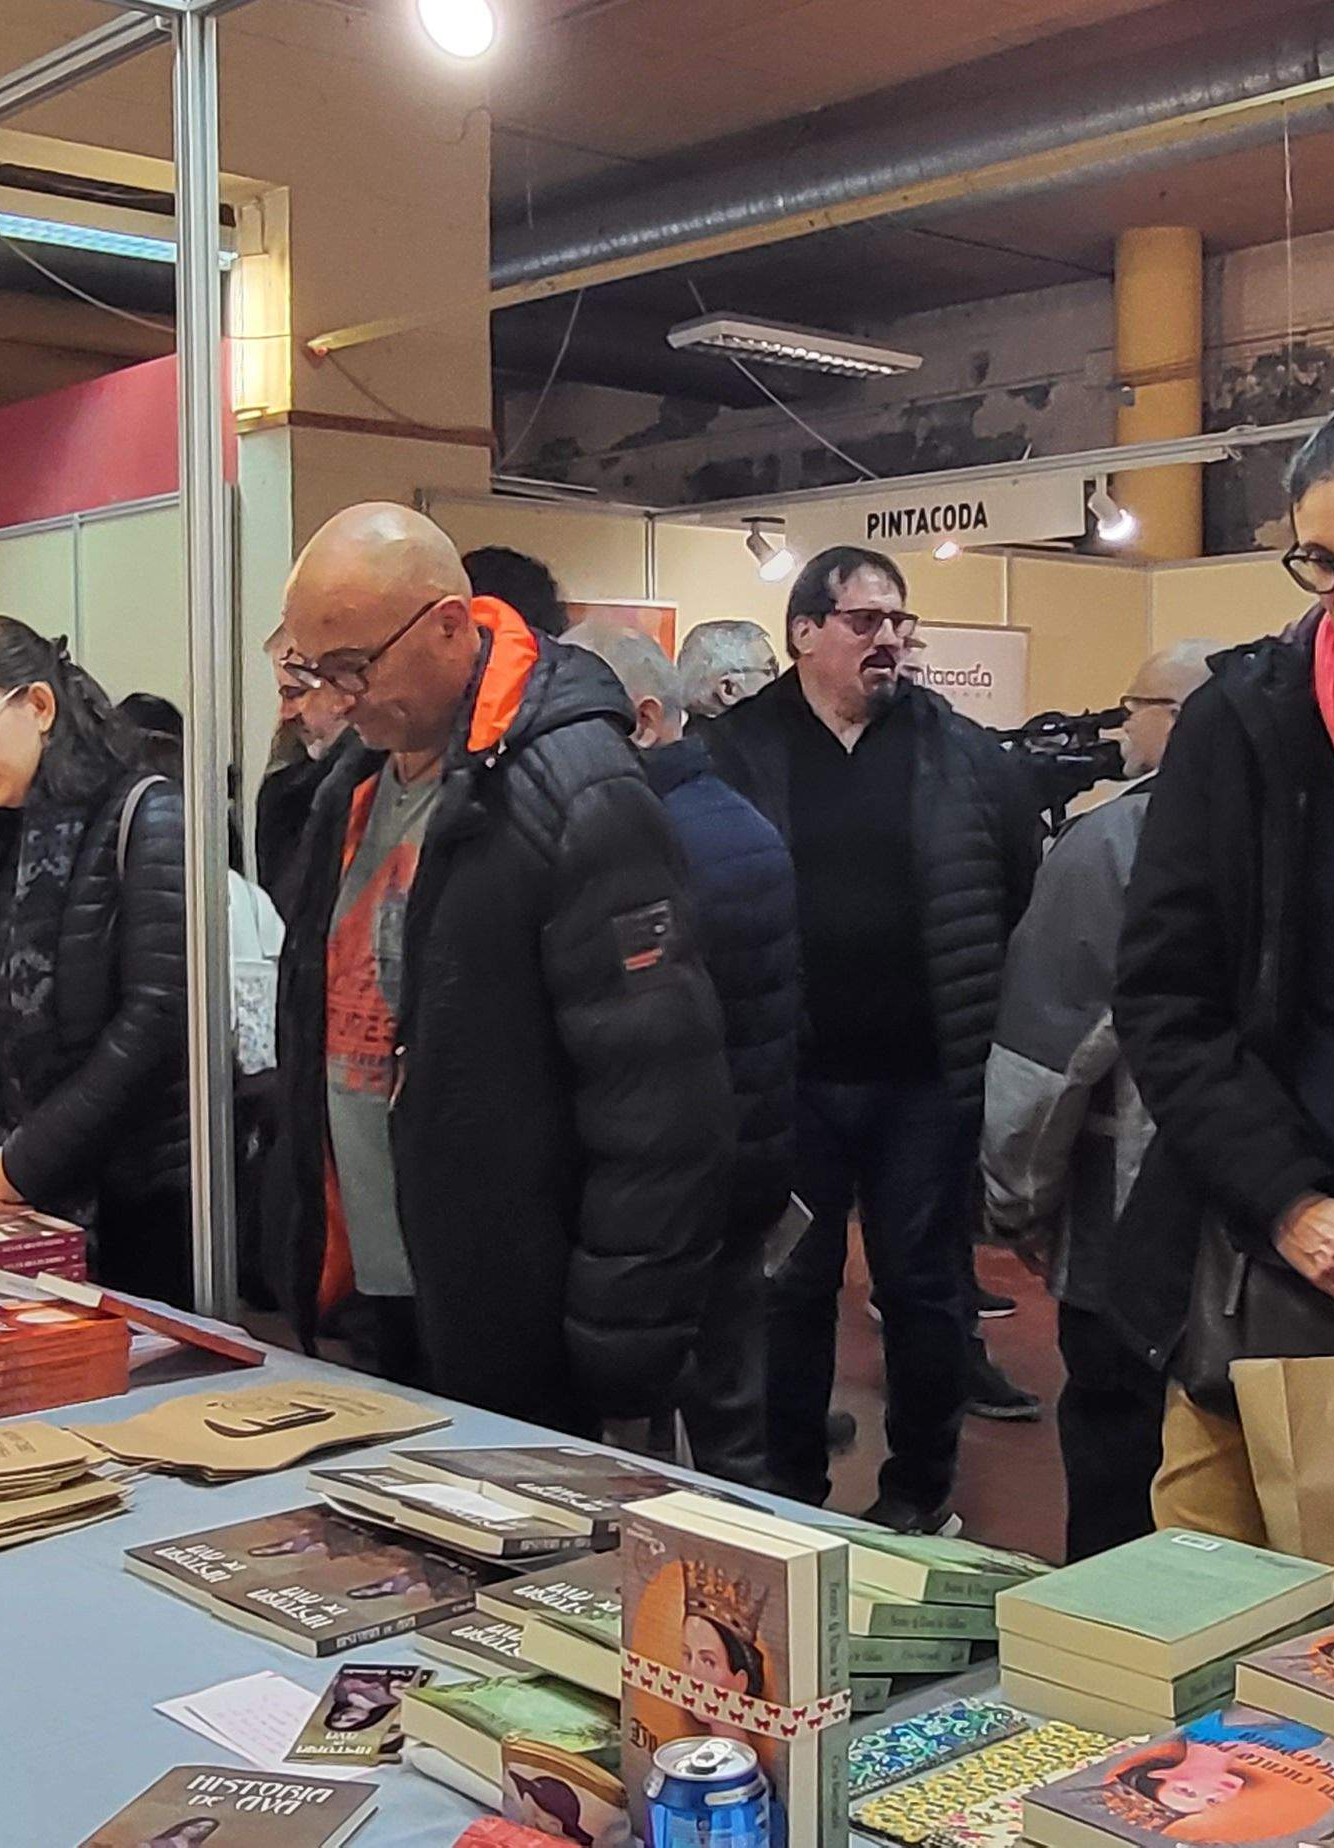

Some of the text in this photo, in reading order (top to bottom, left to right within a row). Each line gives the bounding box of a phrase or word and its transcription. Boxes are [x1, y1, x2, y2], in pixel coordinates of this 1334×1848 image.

[867, 500, 988, 539] PINTACODA
[187, 1774, 335, 1804] HISTORIA
[188, 1794, 304, 1816] DE AVA
